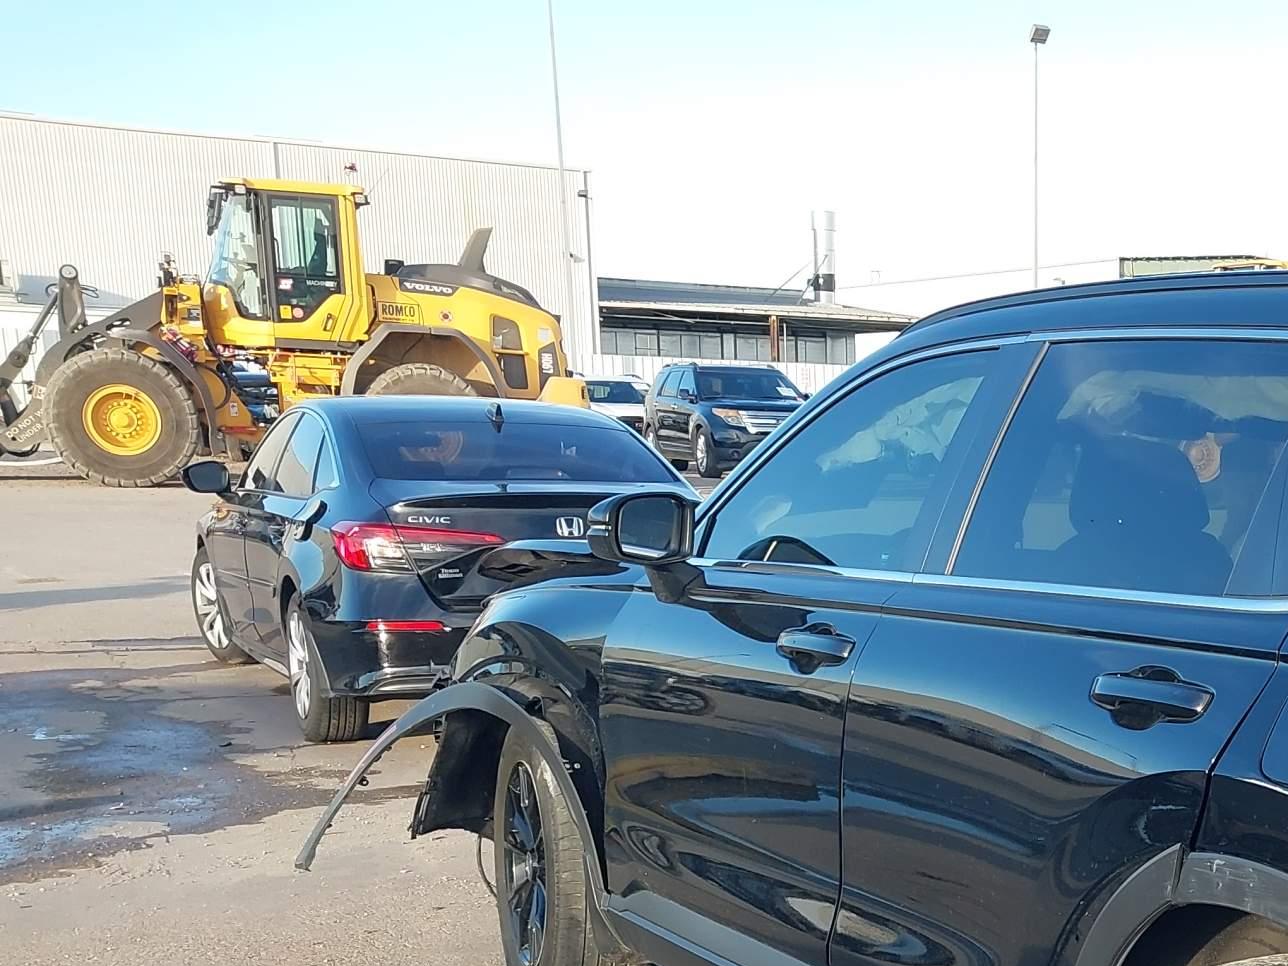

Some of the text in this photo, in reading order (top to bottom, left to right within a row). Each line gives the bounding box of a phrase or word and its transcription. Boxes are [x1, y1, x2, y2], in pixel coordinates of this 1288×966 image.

[403, 281, 453, 294] VOLVO
[381, 303, 415, 318] ROMCO
[6, 426, 19, 438] DO
[18, 415, 35, 430] NOT
[16, 423, 44, 442] UNDER
[407, 515, 451, 524] CIVIC
